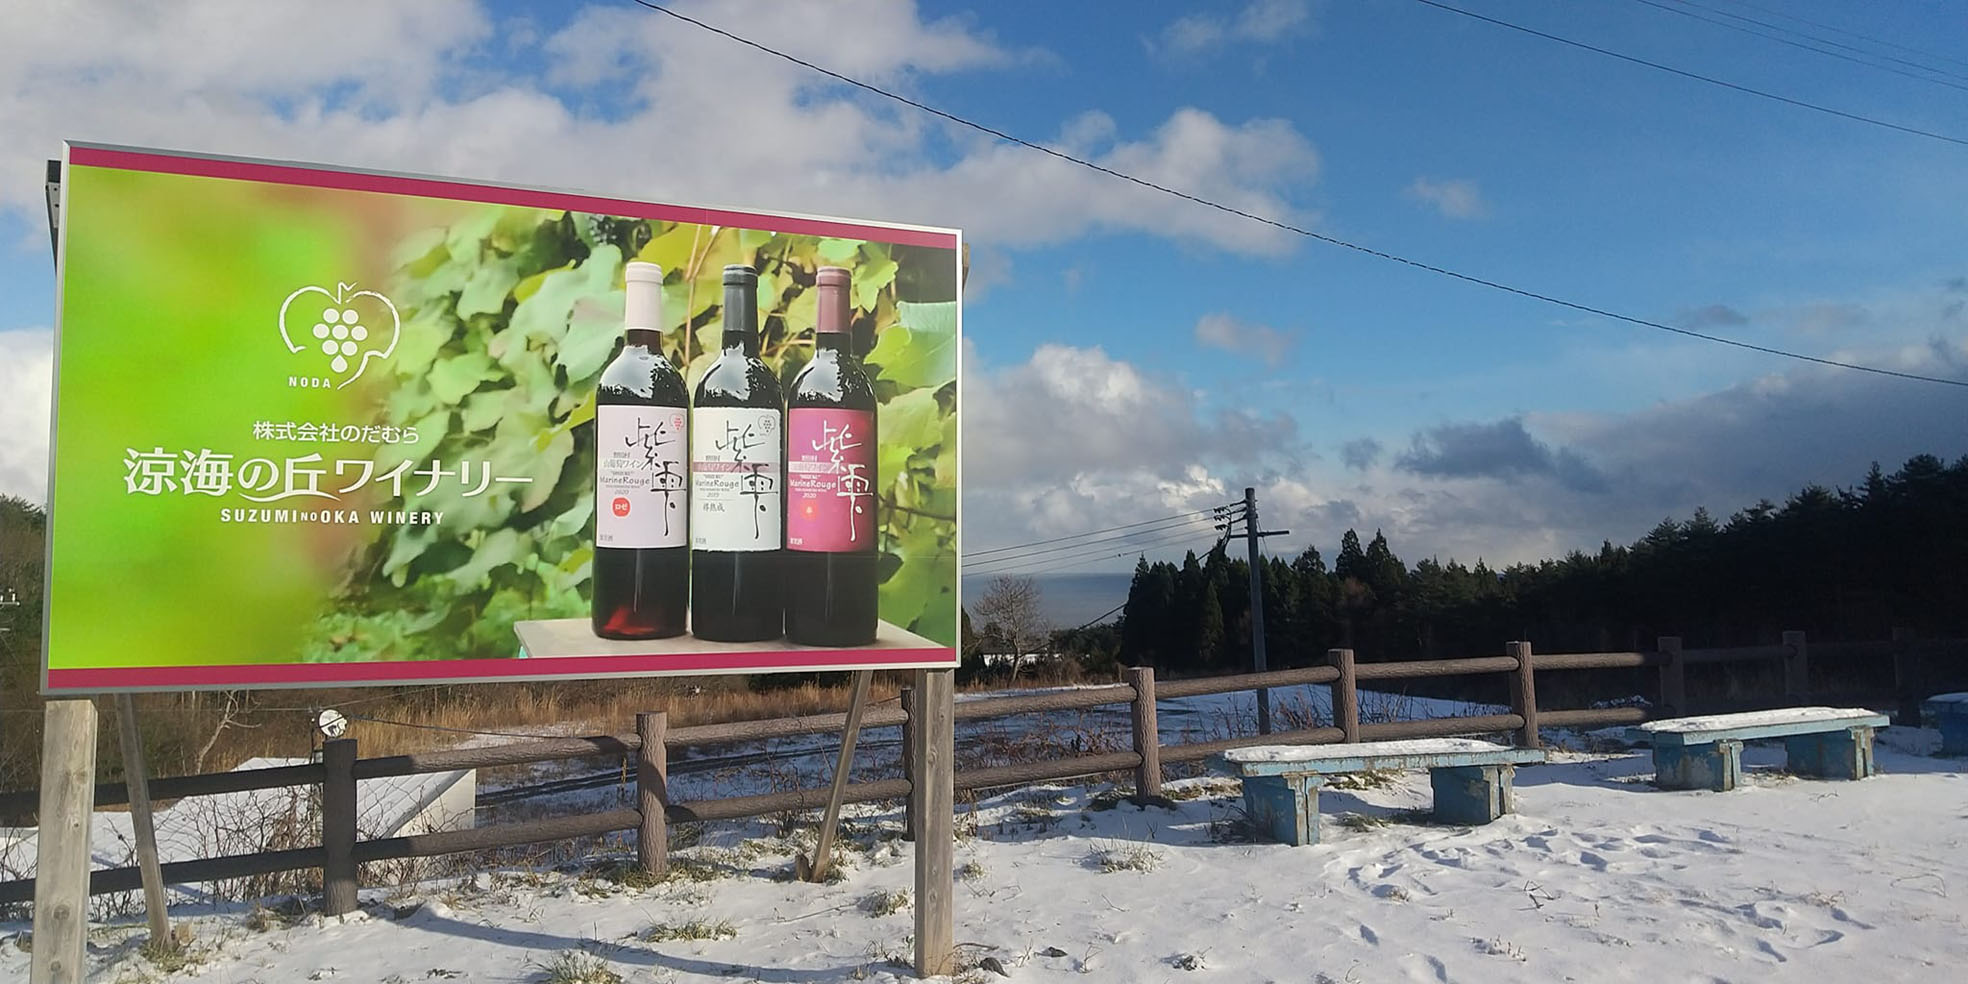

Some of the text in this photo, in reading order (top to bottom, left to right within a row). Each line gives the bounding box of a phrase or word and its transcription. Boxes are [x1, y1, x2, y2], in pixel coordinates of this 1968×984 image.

[288, 375, 331, 389] NODA
[252, 420, 420, 445] 株式会社のだむら
[122, 446, 534, 500] 涼海の丘ワイナリー
[369, 510, 445, 525] WINERY
